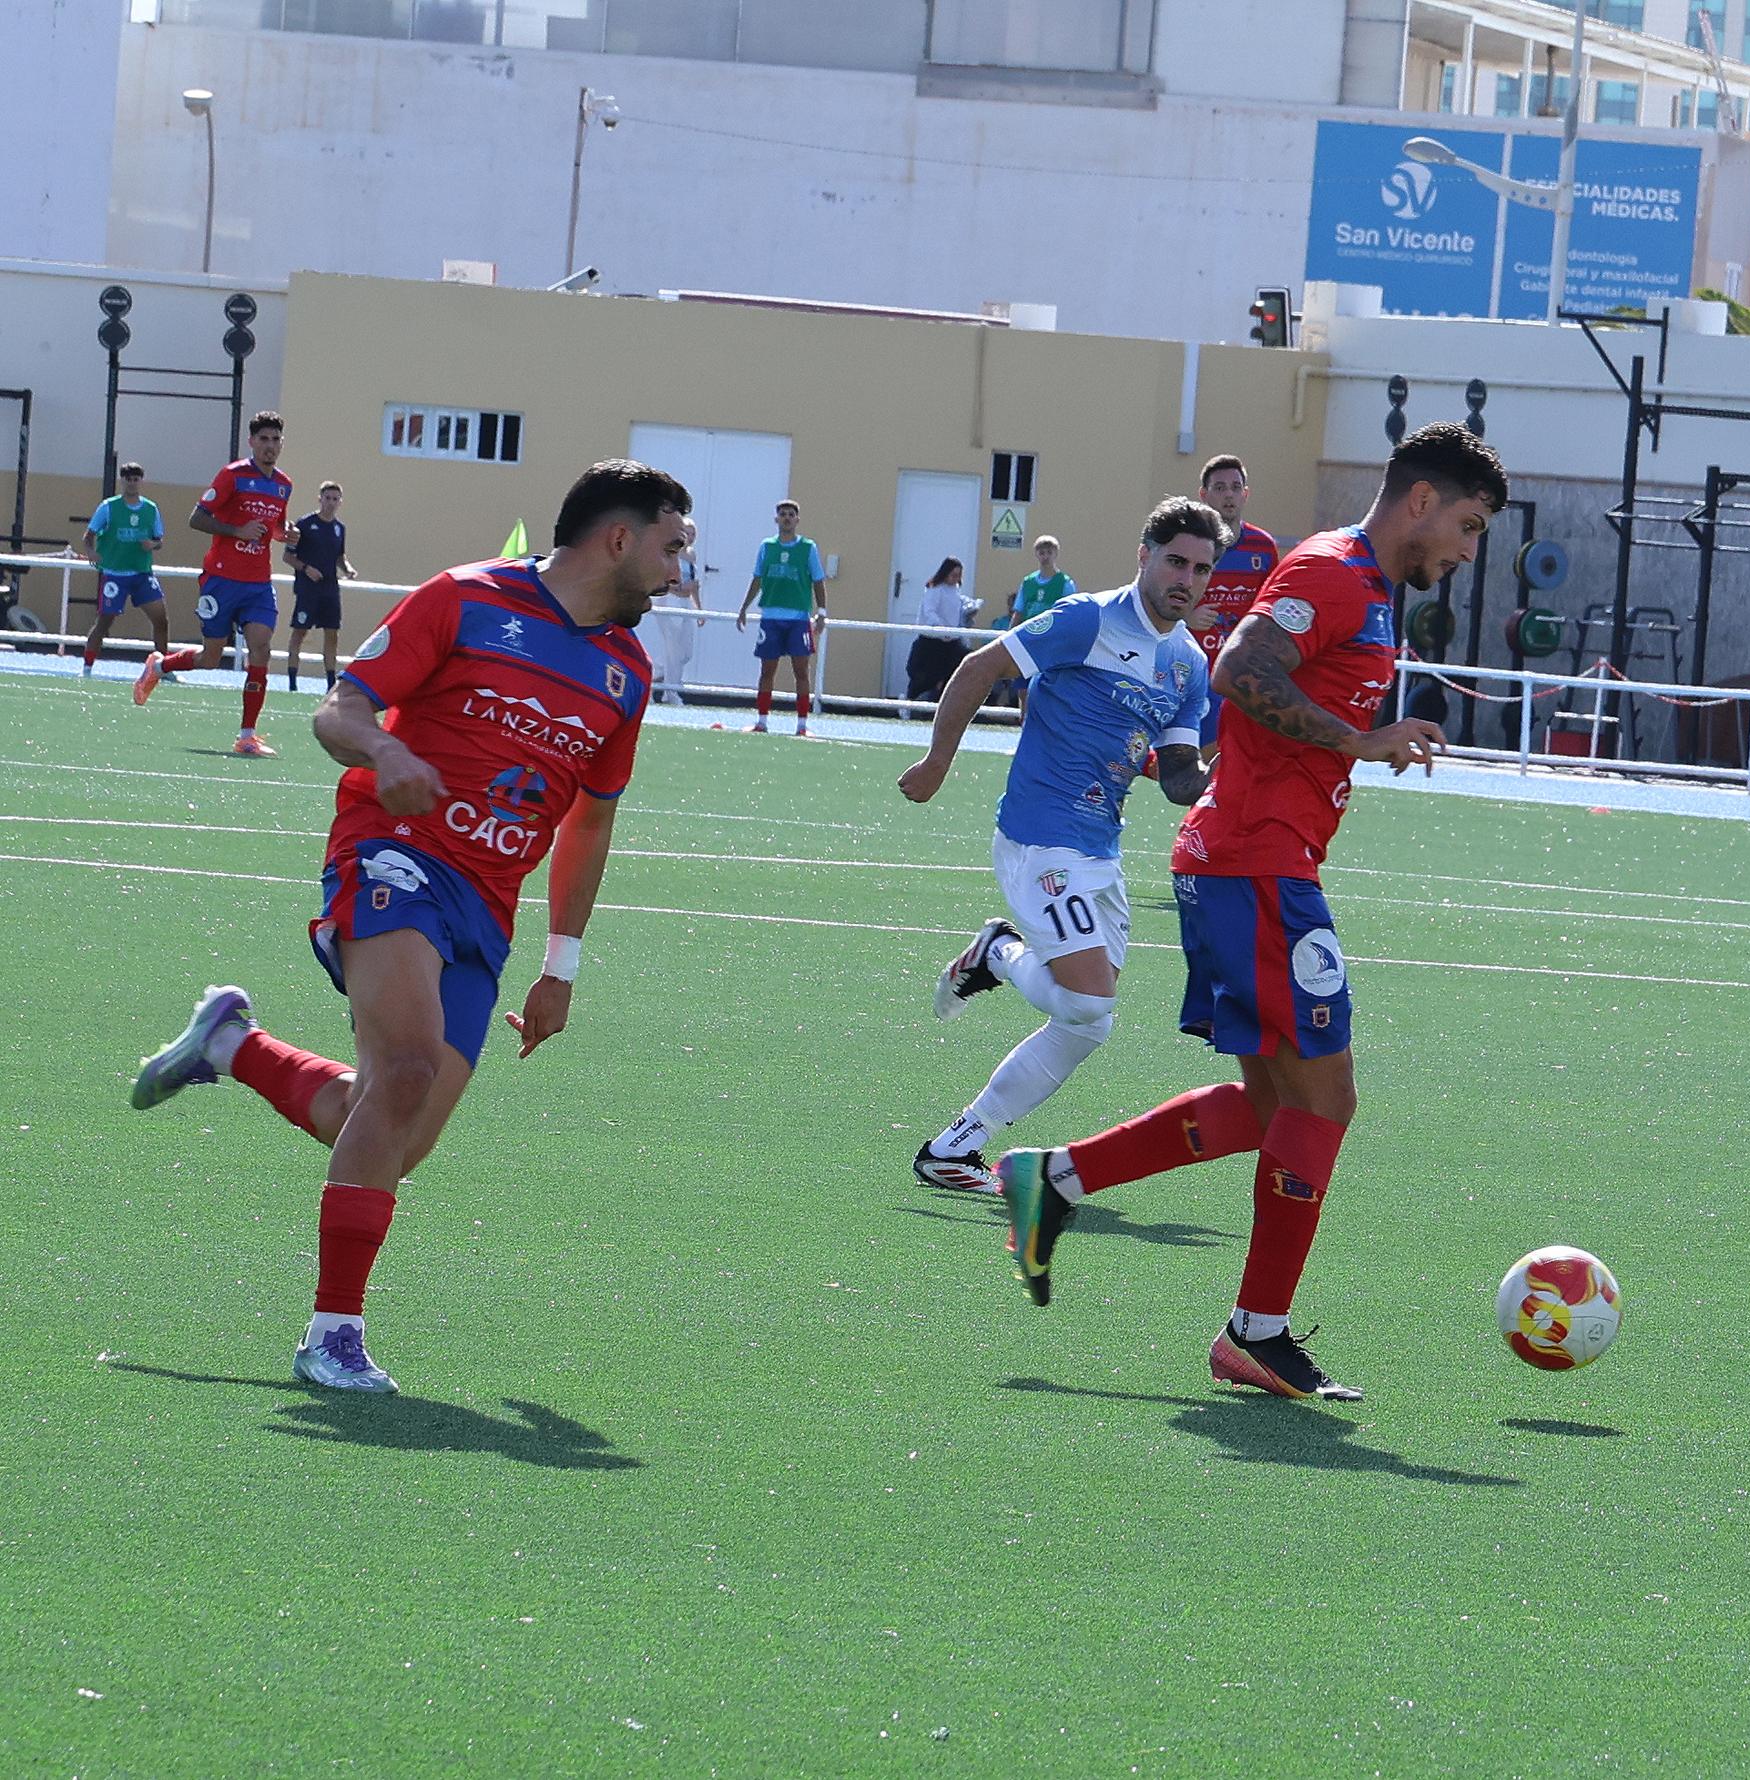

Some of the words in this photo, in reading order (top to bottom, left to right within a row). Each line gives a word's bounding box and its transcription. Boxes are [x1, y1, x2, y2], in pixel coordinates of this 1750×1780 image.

[1335, 222, 1381, 247] San
[1386, 225, 1476, 254] Vicente
[445, 801, 539, 859] CACT
[1042, 894, 1095, 942] 10
